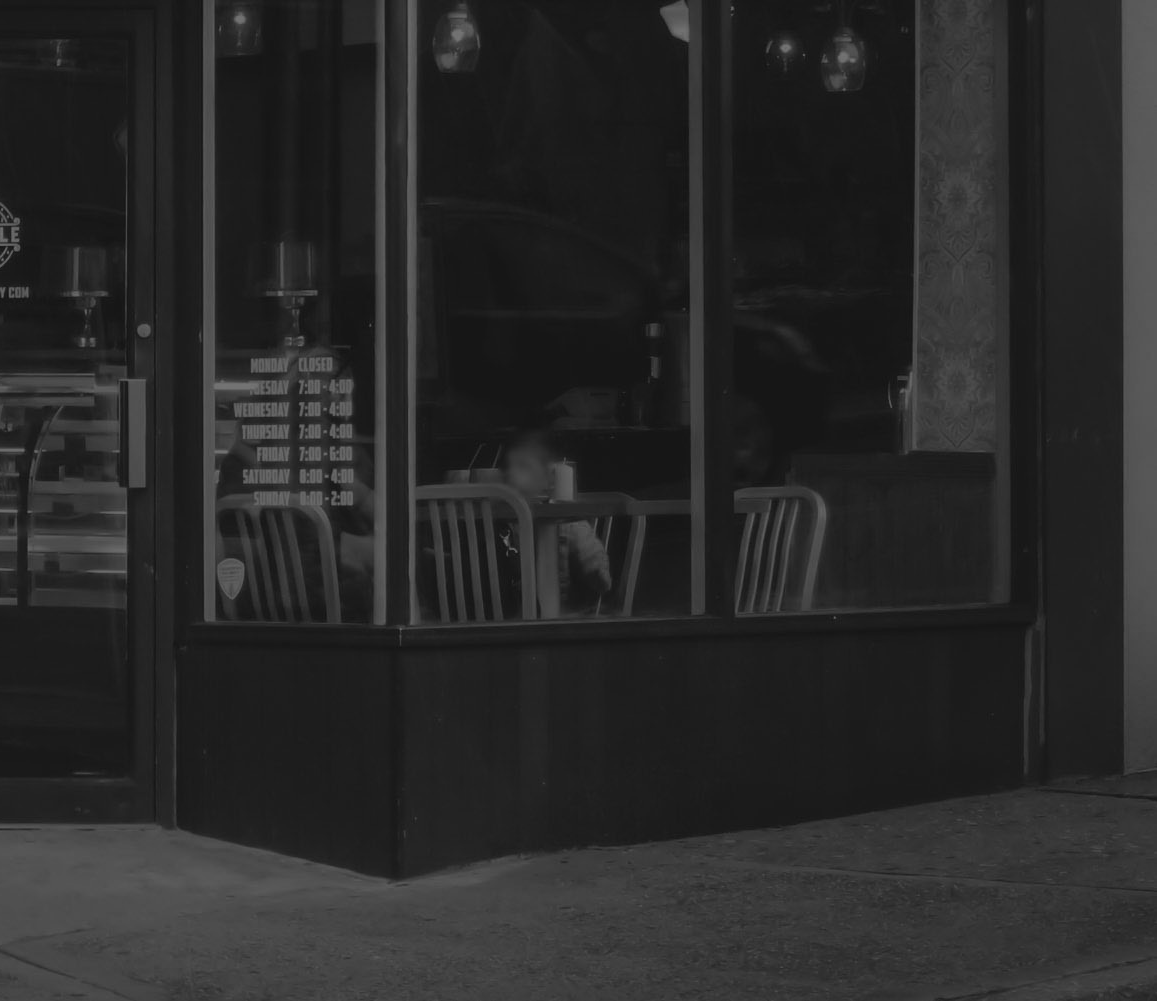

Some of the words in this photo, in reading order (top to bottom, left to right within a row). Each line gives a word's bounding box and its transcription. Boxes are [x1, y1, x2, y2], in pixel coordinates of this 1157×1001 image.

[250, 357, 290, 373] MONDAY
[298, 356, 333, 373] CLOSED
[298, 379, 321, 395] 7:00
[329, 378, 354, 395] 4:00
[233, 401, 290, 418] WEDNESDAY
[298, 401, 322, 417] 7:00
[329, 401, 354, 417] 4:00
[242, 424, 290, 440] THURSDAY
[298, 423, 322, 440] 7:00
[329, 423, 353, 440] 4:00
[256, 446, 290, 462] FRIDAY
[299, 446, 322, 462] 7:00
[329, 446, 353, 462] 6:00
[242, 468, 290, 484] SATURDAY
[330, 468, 354, 484] 4:00
[253, 490, 291, 506] SUNDAY
[330, 490, 354, 506] 2:00
